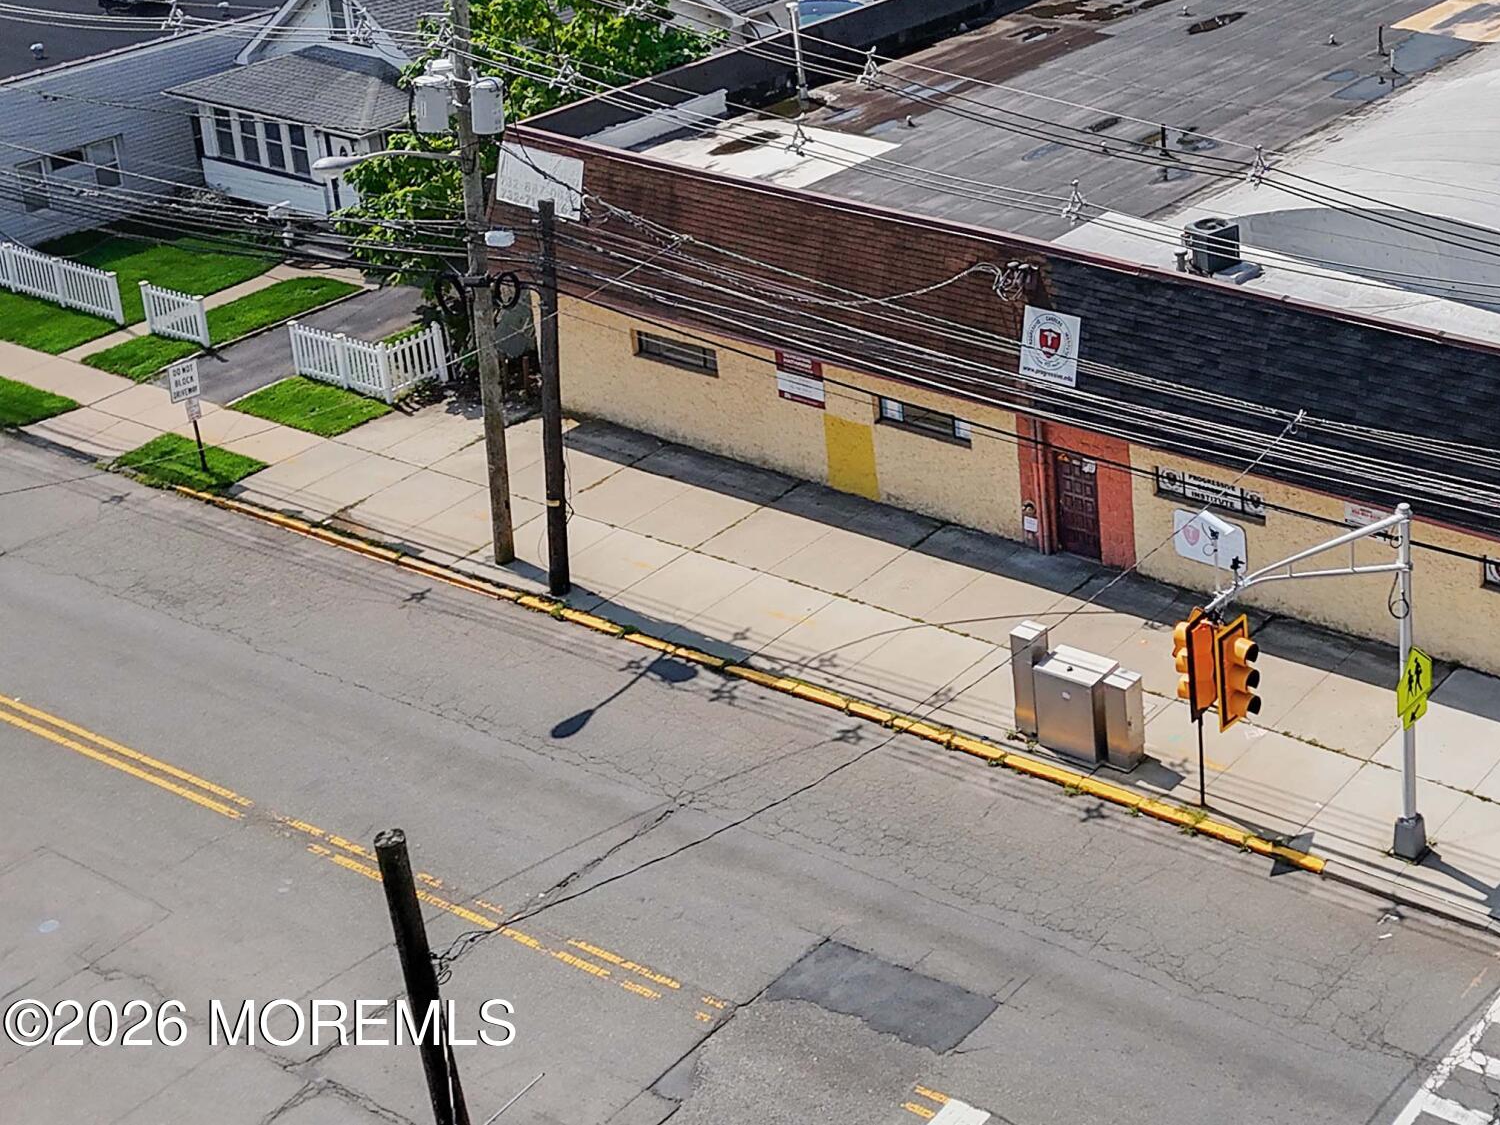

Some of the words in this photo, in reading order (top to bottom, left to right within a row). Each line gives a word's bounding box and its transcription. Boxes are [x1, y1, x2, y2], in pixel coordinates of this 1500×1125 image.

[172, 367, 181, 377] DO
[182, 363, 193, 374] NOT
[175, 375, 194, 388] BLOCK
[173, 385, 198, 400] DRIVEWAY
